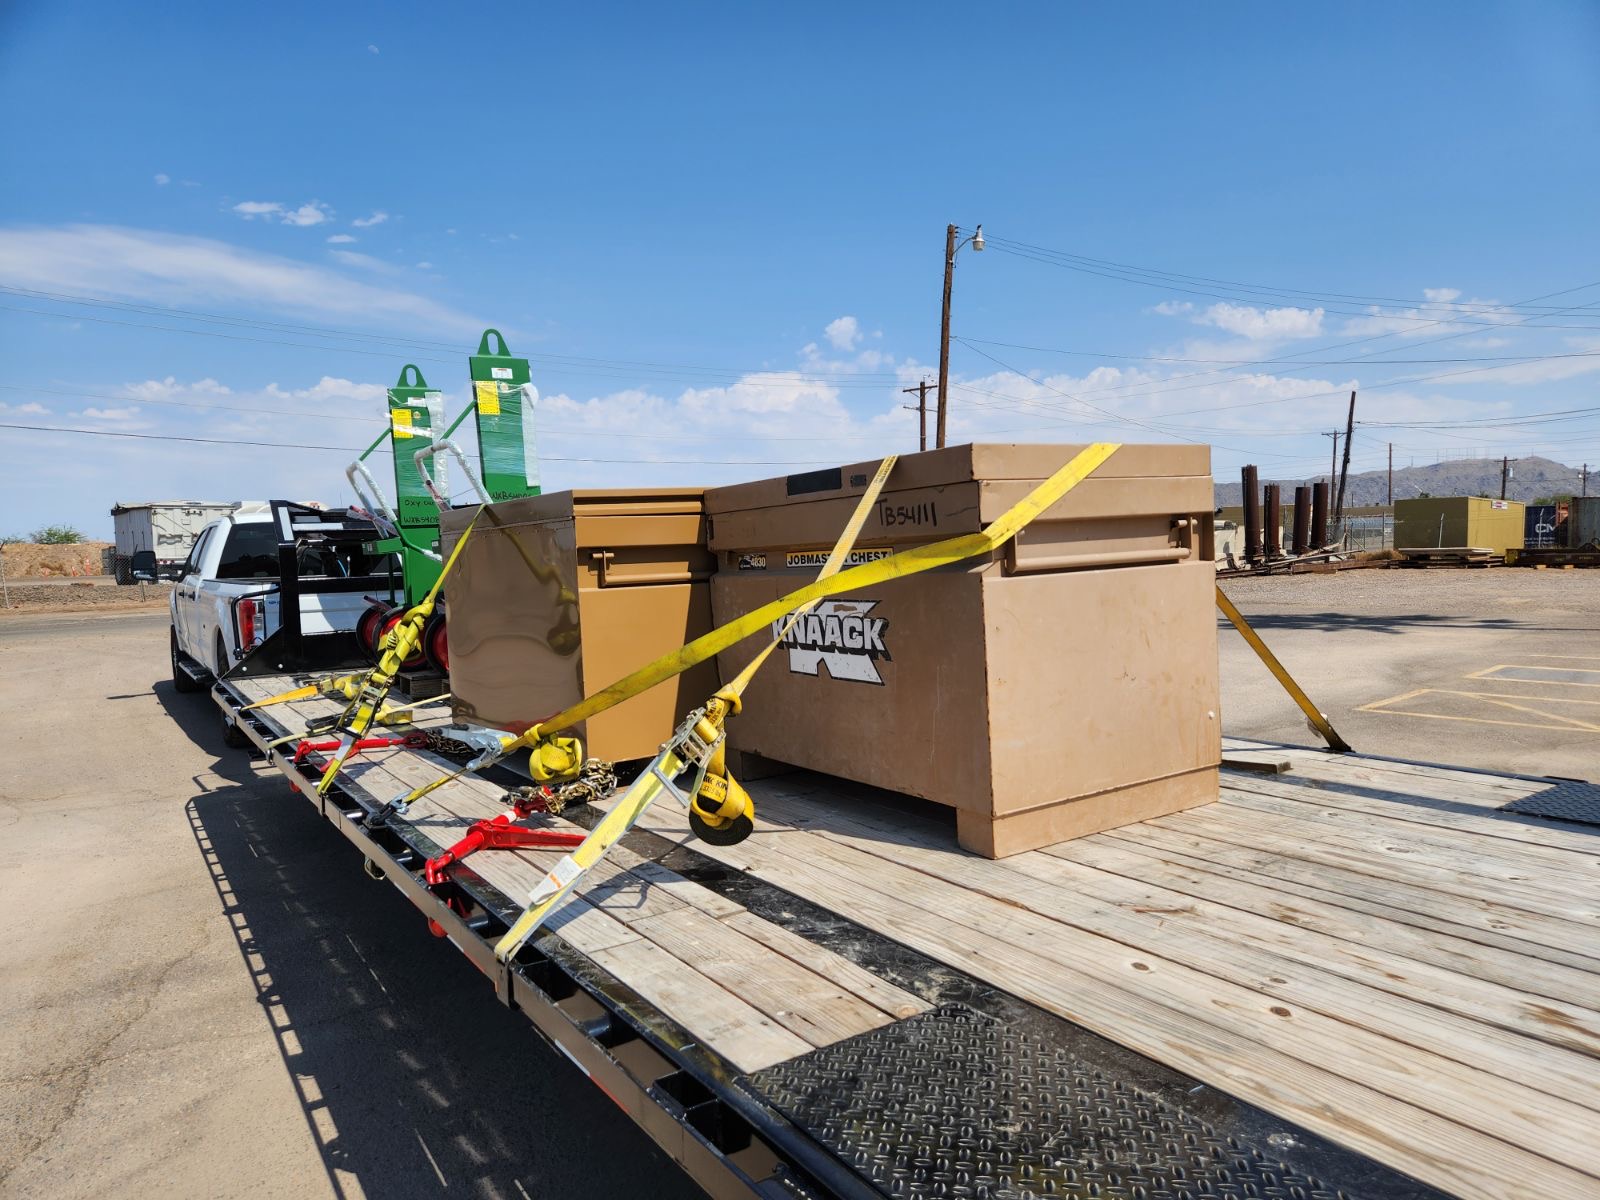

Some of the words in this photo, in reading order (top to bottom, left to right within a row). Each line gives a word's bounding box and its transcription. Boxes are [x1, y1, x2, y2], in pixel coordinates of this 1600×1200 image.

[875, 499, 938, 527] TB54111
[788, 552, 849, 566] JOBMAS
[851, 551, 888, 563] CHEST
[771, 613, 889, 654] KNAACK
